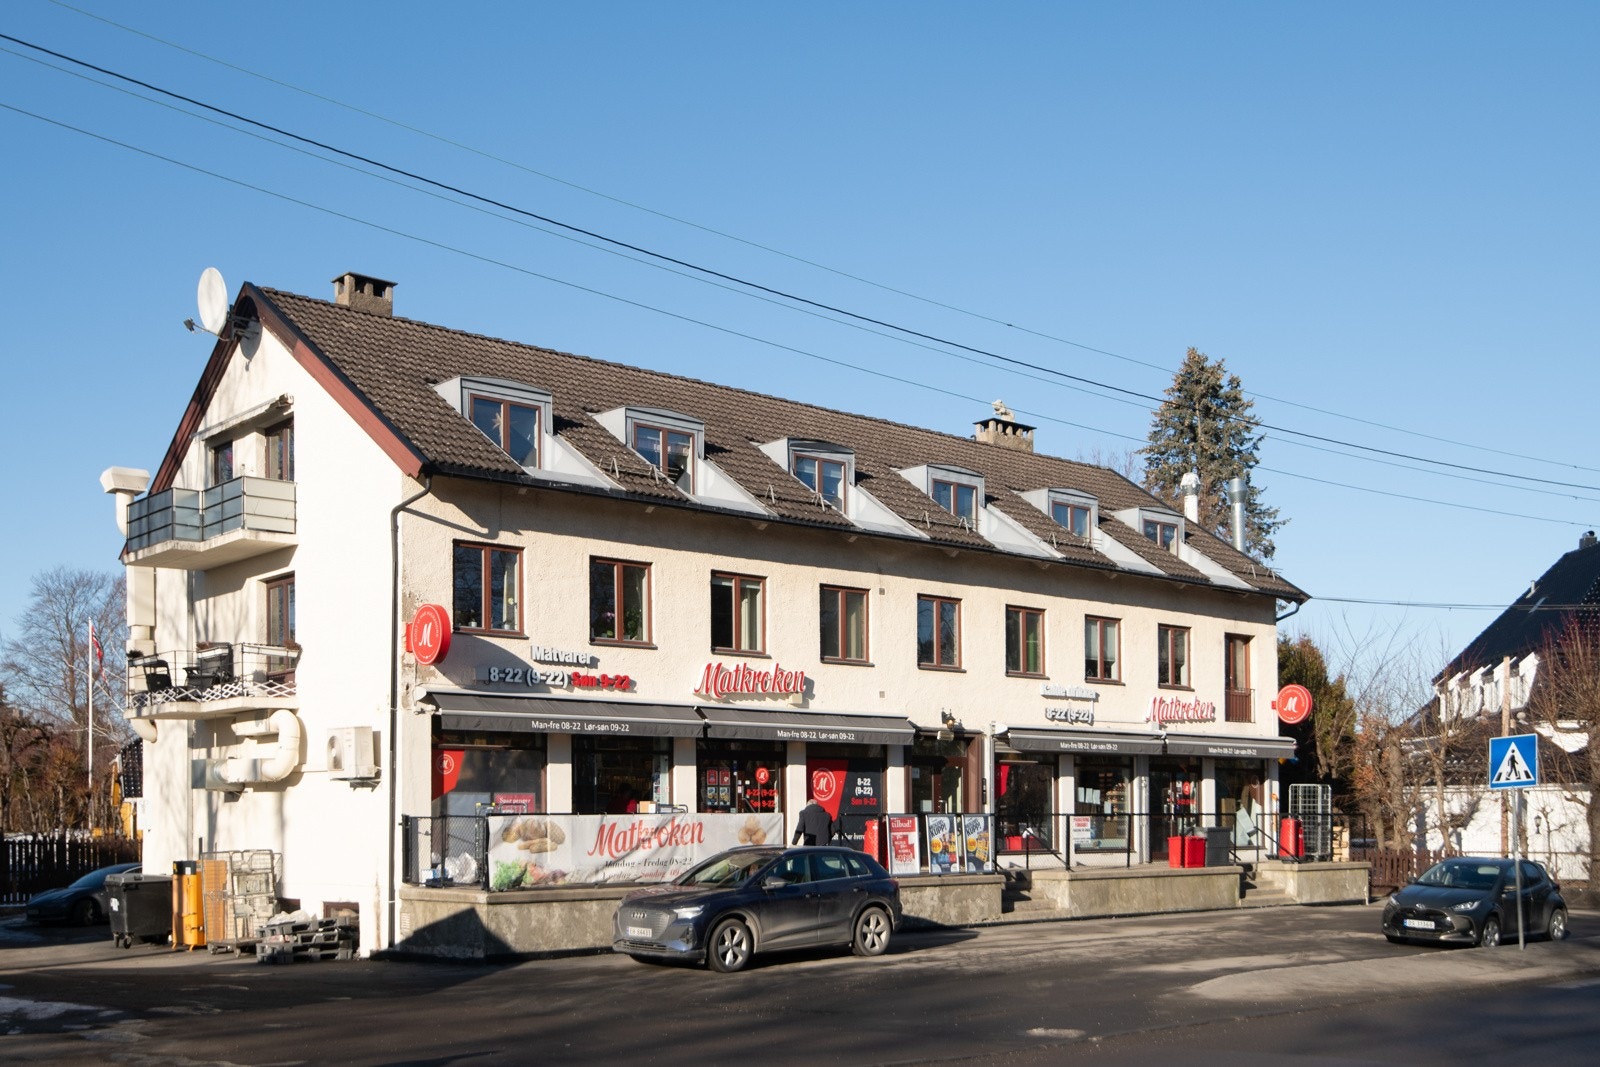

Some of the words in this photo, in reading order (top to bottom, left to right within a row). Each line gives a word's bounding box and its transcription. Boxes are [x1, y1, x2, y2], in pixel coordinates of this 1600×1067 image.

[530, 644, 592, 665] Matvarer
[489, 666, 523, 683] 8-22
[526, 668, 568, 688] (9-22)
[570, 671, 597, 688] Søn
[599, 673, 631, 690] 9-22
[693, 661, 806, 699] Matkroken
[1046, 708, 1067, 720] 8-22
[1145, 695, 1215, 724] Matkroken
[531, 720, 560, 730] Man-fre
[560, 721, 581, 731] 08-22
[584, 722, 610, 732] Lør-søn
[610, 723, 630, 732] 09-22
[776, 729, 800, 738] Man-fre
[800, 731, 816, 739] 08-22
[839, 732, 855, 740] 09-22
[856, 777, 871, 786] 8-22
[891, 819, 912, 828] tilbud!
[587, 816, 705, 860] Matkroken
